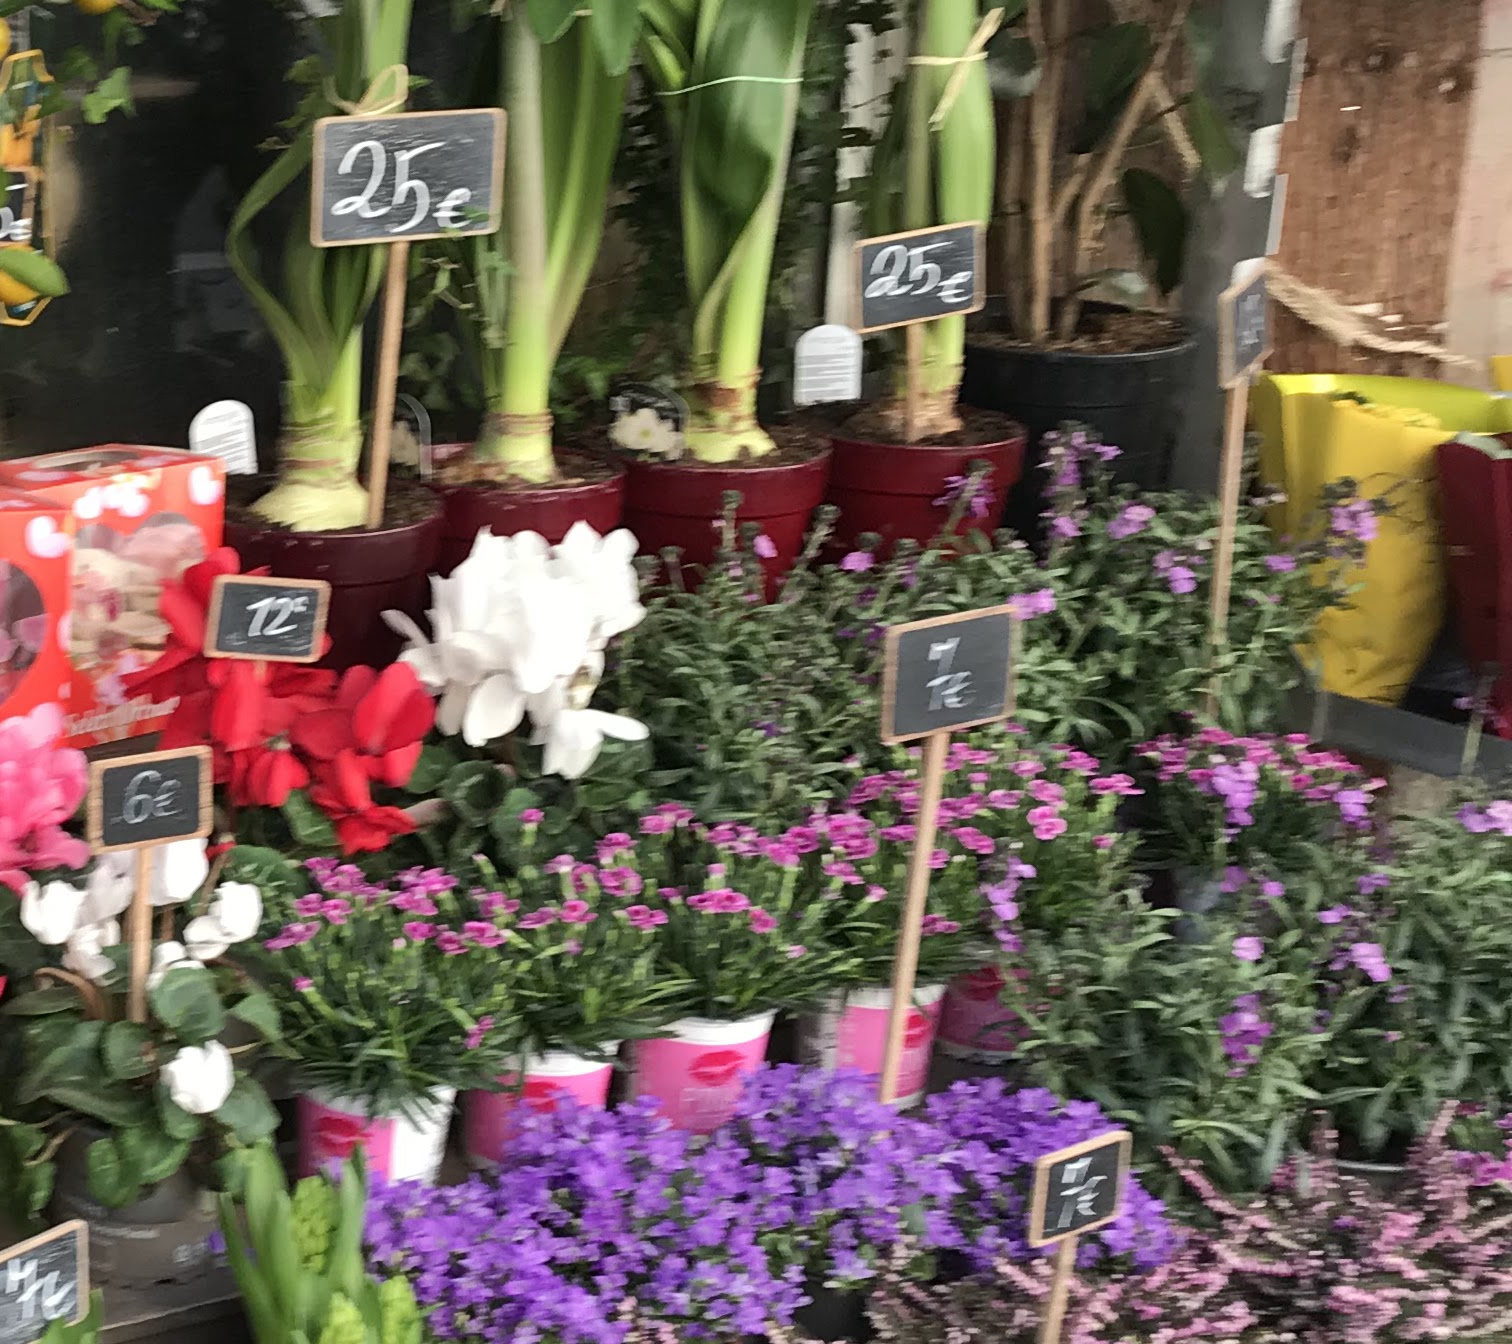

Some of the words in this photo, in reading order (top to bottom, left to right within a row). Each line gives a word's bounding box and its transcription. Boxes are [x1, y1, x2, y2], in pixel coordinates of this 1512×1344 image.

[330, 139, 473, 233] 25€
[864, 240, 973, 304] 25€
[123, 769, 183, 825] 6€
